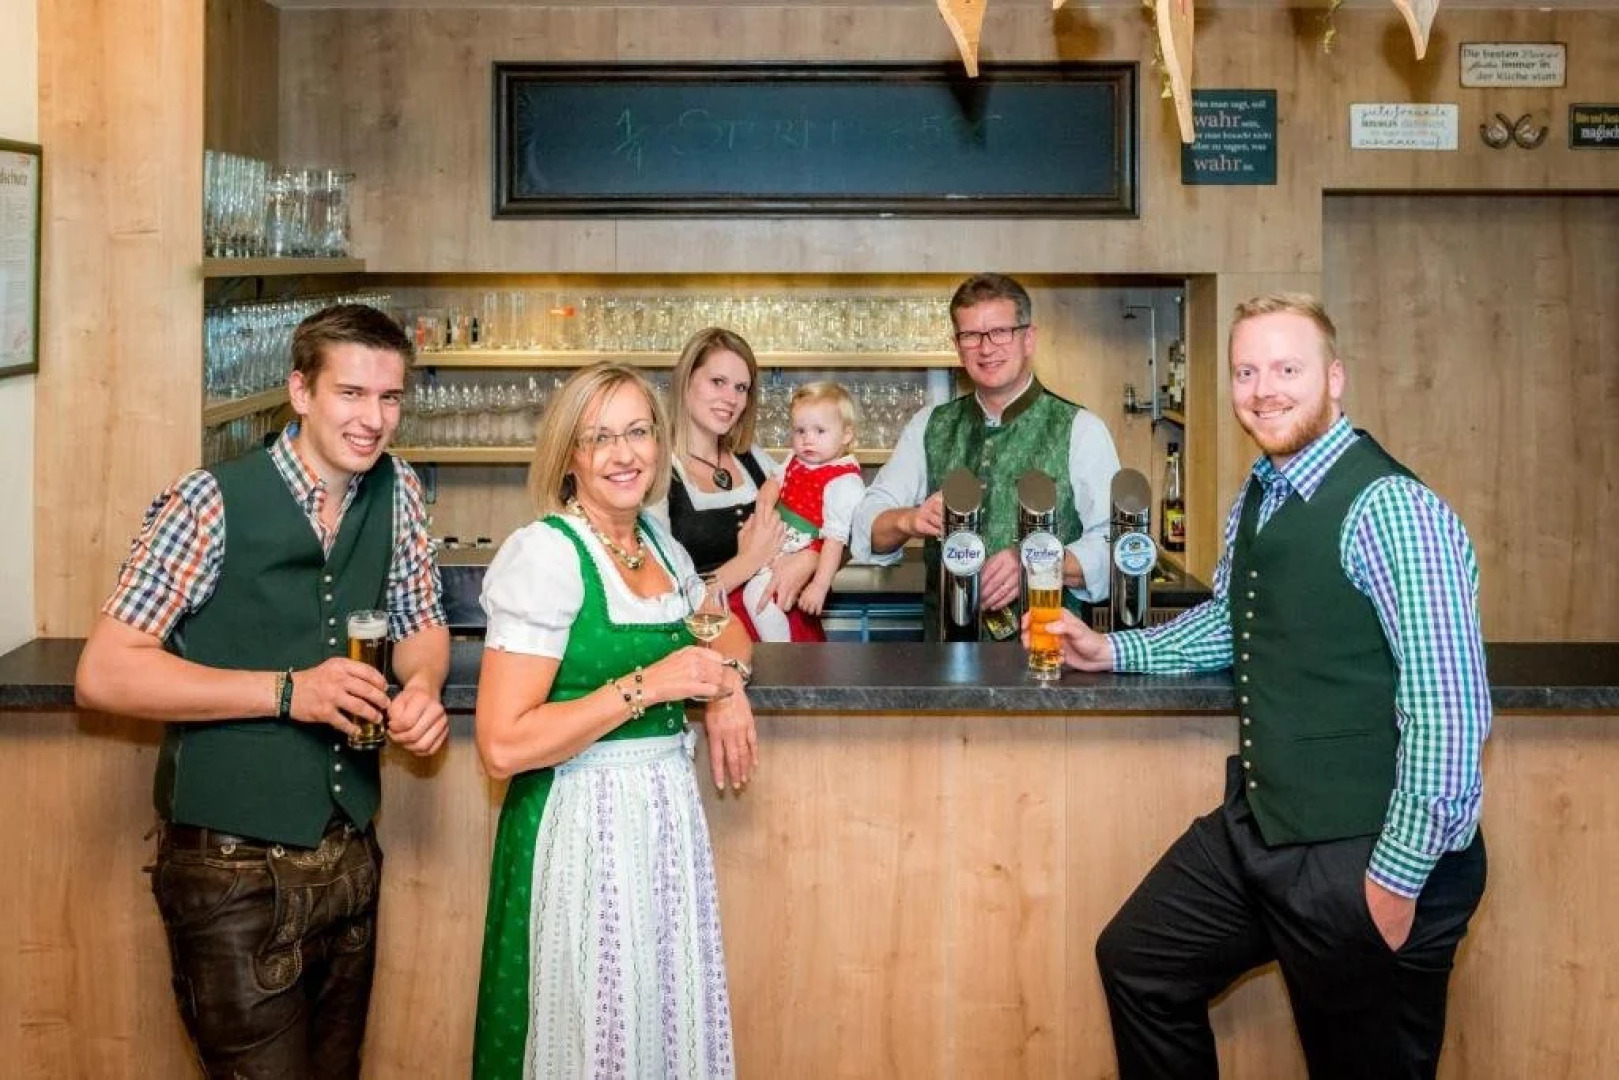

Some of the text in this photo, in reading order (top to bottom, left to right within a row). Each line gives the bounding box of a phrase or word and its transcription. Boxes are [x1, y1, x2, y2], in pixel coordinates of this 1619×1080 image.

[1463, 48, 1480, 58] Die
[1483, 48, 1519, 58] besten
[1501, 61, 1538, 70] immer
[1210, 101, 1228, 109] man
[1230, 101, 1250, 111] sagt,
[1194, 110, 1242, 128] wahr
[1193, 154, 1242, 171] wahr
[946, 546, 981, 561] Zipfer
